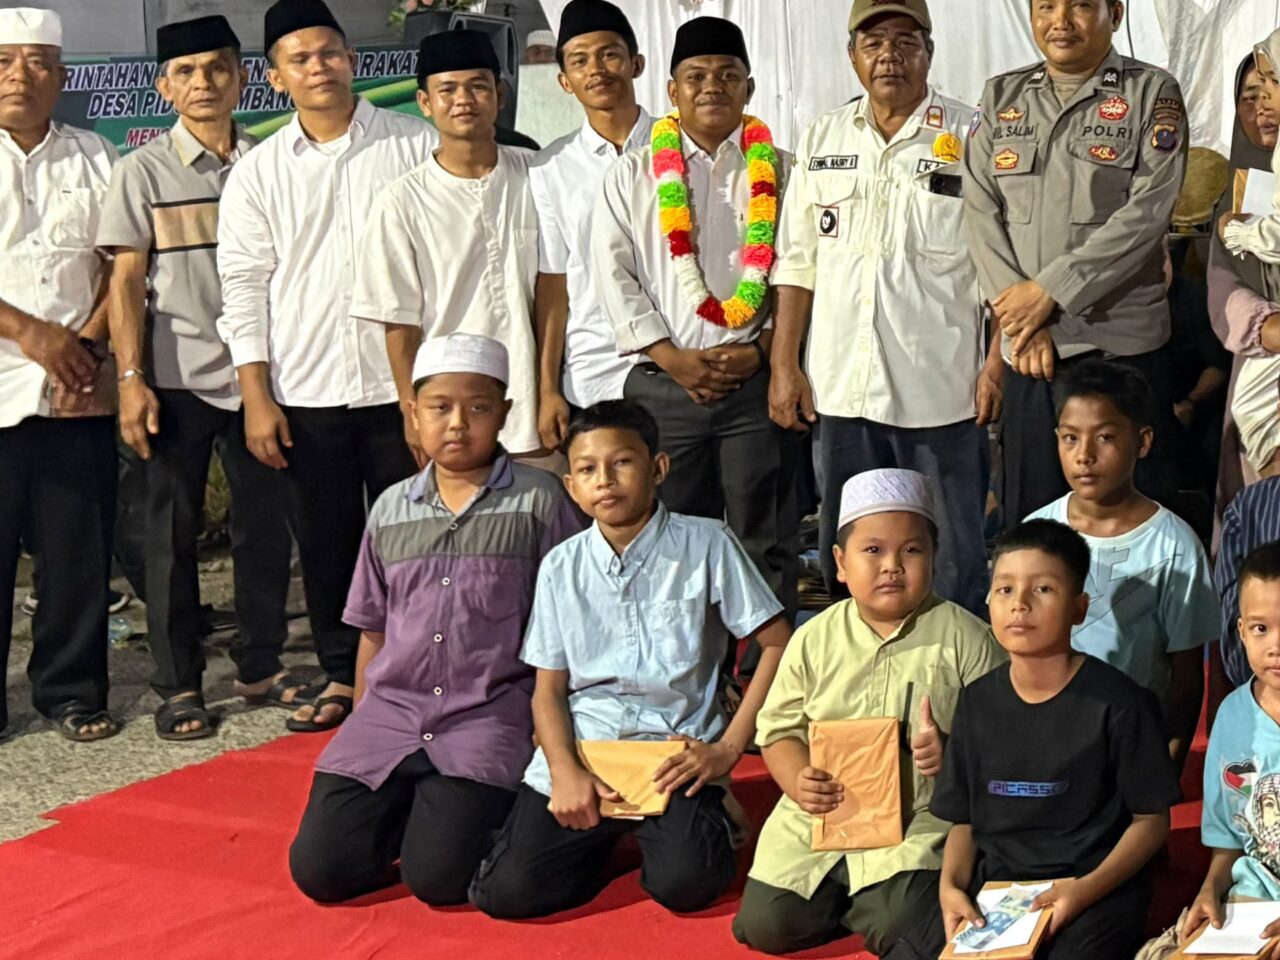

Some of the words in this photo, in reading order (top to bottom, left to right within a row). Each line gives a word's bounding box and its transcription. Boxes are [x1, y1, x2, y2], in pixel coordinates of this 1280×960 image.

[63, 61, 158, 91] RINTAHAN
[352, 49, 421, 79] RAKA
[88, 90, 139, 118] DESA
[140, 90, 180, 117] PID
[231, 85, 297, 112] MBAN
[125, 126, 171, 149] MEN
[1082, 124, 1133, 141] POLRI
